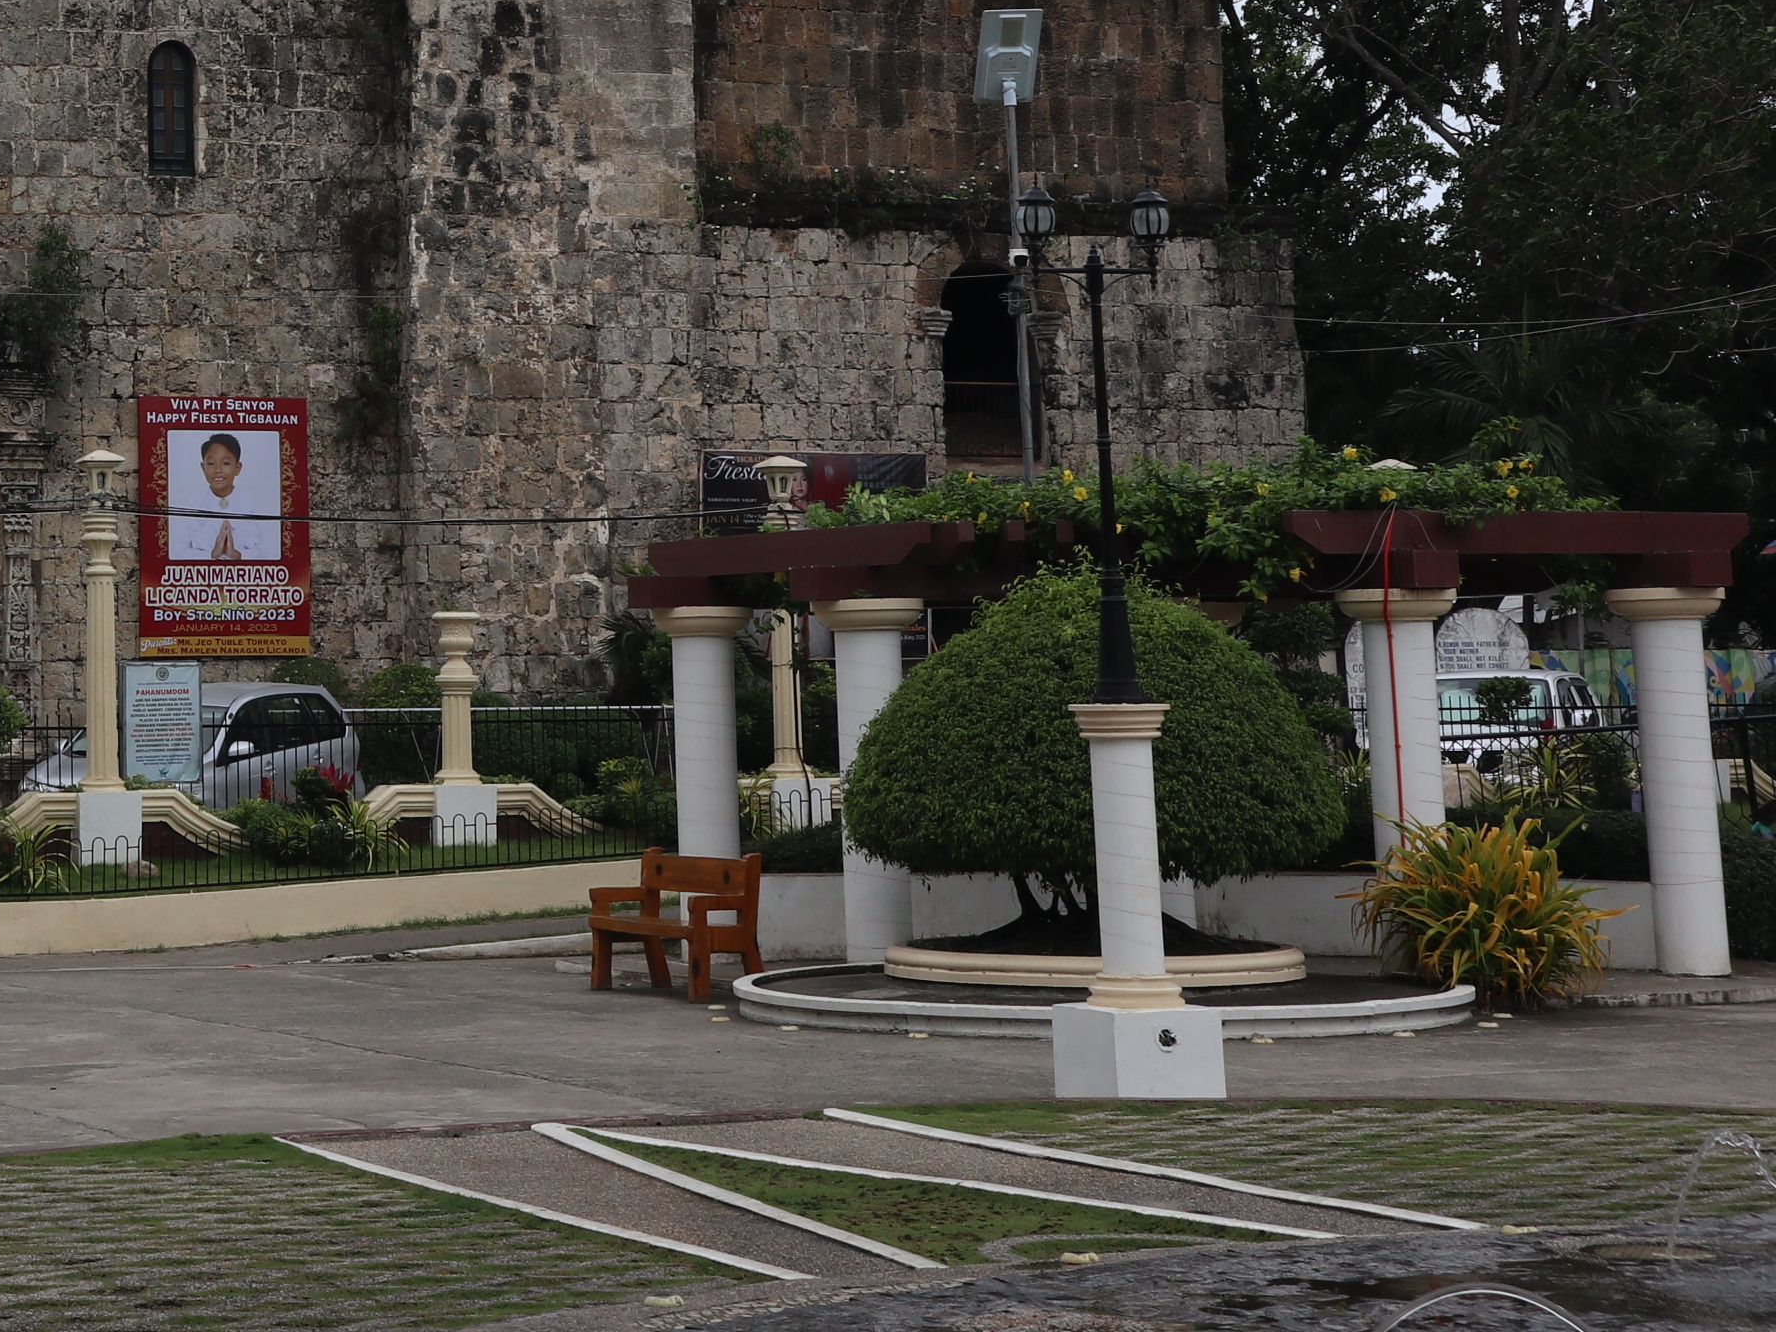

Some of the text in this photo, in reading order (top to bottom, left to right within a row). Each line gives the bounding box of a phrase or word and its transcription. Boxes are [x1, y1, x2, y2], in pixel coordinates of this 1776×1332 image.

[170, 398, 275, 411] VIVA PIT SENYOR
[146, 412, 299, 425] HAPPY FIESTA TIGBAUAN
[706, 515, 740, 524] JAN 14
[162, 566, 289, 585] JUAN MARIANO
[146, 587, 304, 606] LICANDA TORRATO
[154, 609, 181, 621] BOY
[222, 608, 255, 621] NIÑO
[258, 609, 296, 621] 2023
[172, 623, 225, 632] JANUARY
[247, 623, 278, 632] 2023
[177, 638, 193, 646] MR.
[196, 638, 213, 646] JEO
[215, 638, 243, 646] TUBLE
[246, 638, 287, 646] TORRATO
[157, 647, 307, 655] MRS. MARLEN NANAGAD LICANDA
[135, 688, 190, 696] PAHANUMDOM
